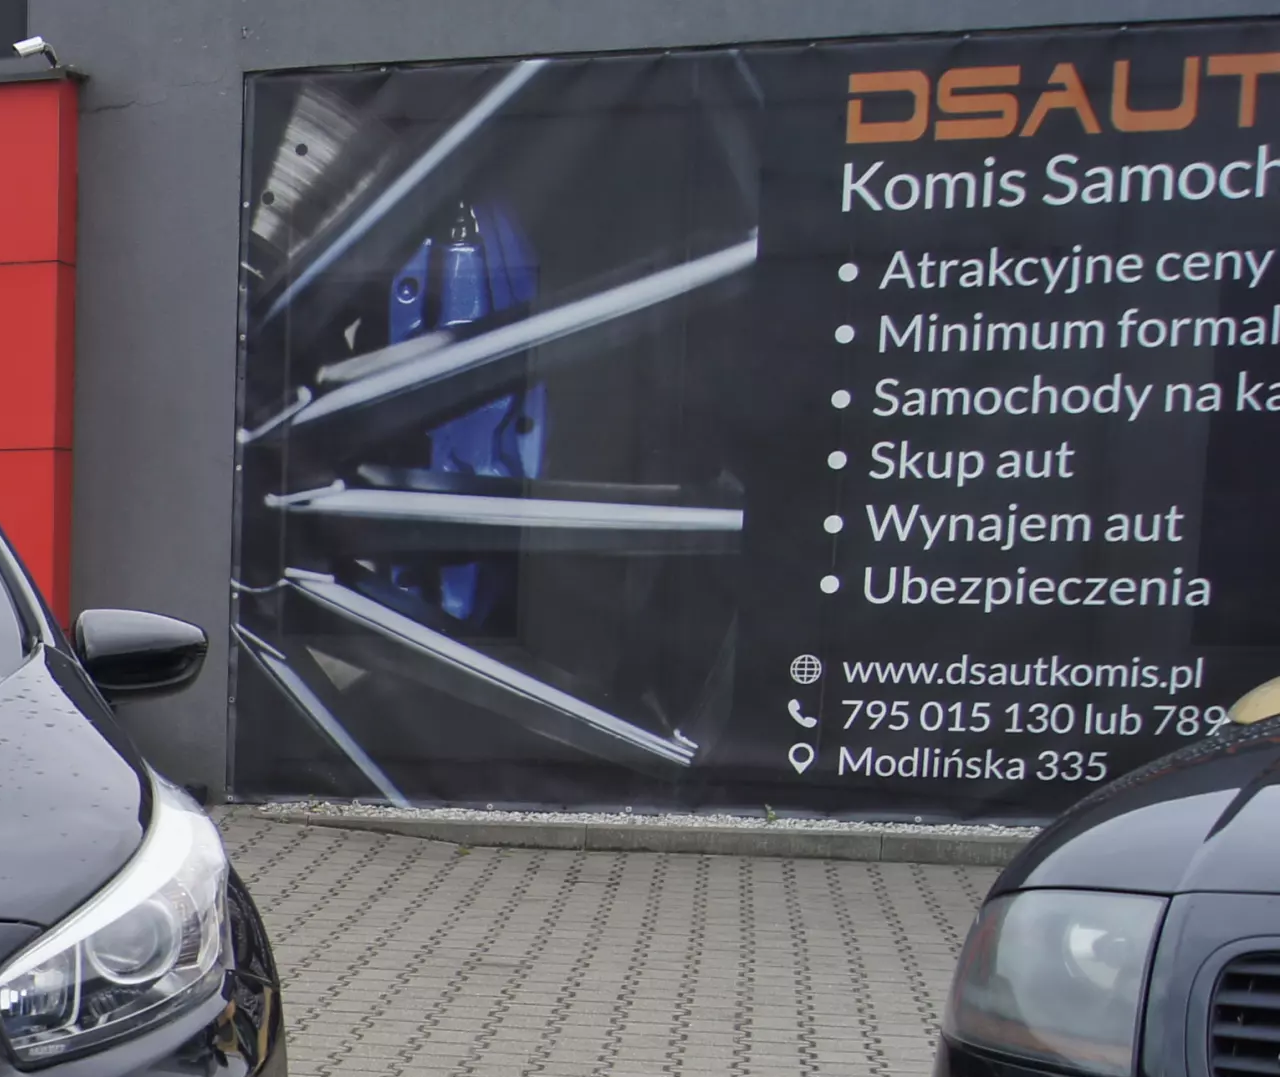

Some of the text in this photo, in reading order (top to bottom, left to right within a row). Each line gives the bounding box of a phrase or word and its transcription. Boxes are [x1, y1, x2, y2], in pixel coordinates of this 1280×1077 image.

[845, 53, 1280, 144] DSAUT
[841, 145, 1280, 213] Komis Samoch
[879, 245, 1275, 294] Atrakcyjne ceny
[878, 304, 1280, 354] Minimum formal
[873, 373, 1152, 421] Samochody
[1164, 383, 1222, 413] na
[868, 441, 1075, 487] Skup aut
[865, 503, 1184, 551] Wynajem aut
[863, 565, 1212, 613] Ubezpieczenia
[842, 654, 1204, 695] www.dsautkomis.pl
[840, 700, 1229, 737] 795 015 130 lub 789
[838, 746, 1108, 782] Modlińska 335
